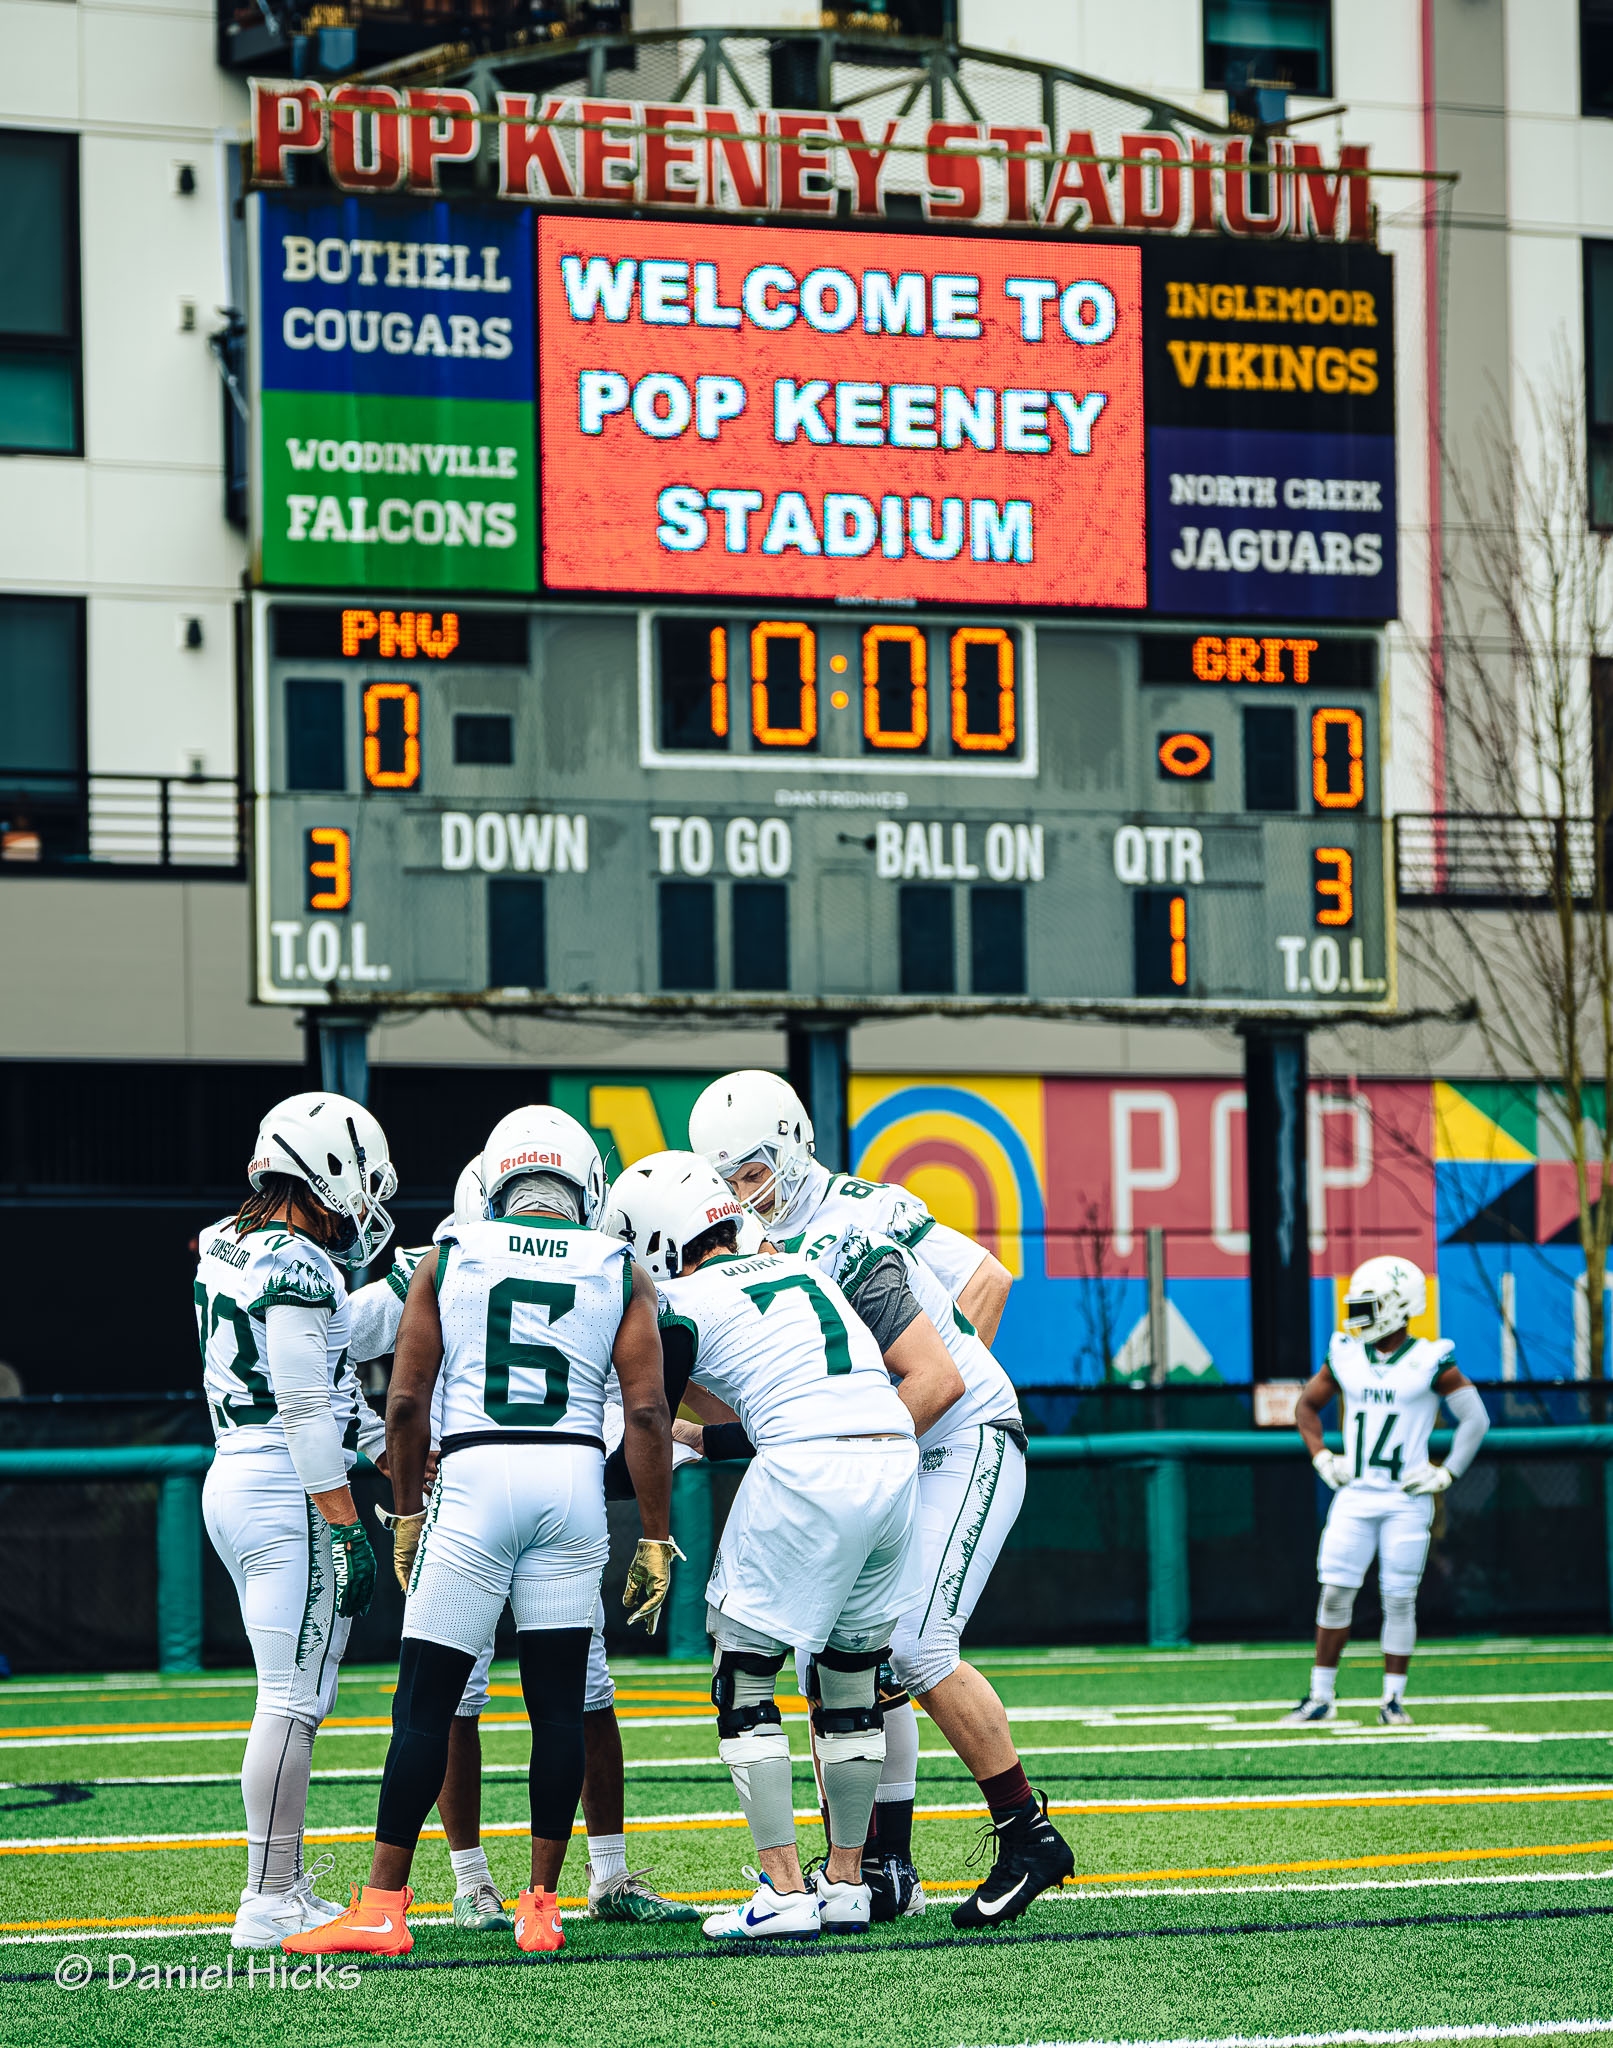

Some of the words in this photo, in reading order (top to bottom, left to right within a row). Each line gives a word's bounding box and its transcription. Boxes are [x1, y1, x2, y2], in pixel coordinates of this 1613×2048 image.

[248, 77, 480, 197] POP
[496, 91, 899, 219] KEENEY
[924, 120, 1374, 243] STADIUM
[282, 235, 512, 292] BOTHELL
[560, 255, 982, 340] WELCOME
[1005, 277, 1117, 346] TO
[1166, 281, 1378, 327] INGLEMOOR
[282, 307, 513, 360] COUGARS
[1167, 340, 1379, 395] VIKINGS
[579, 369, 748, 441] POP
[774, 378, 1107, 456] KEENEY
[286, 437, 518, 479] WOODINVILLE
[286, 494, 518, 548] FALCONS
[1169, 473, 1277, 509] NORTH
[1283, 477, 1383, 512] CREEK
[656, 484, 1035, 564] STADIUM
[1171, 526, 1383, 576] JAGUARS
[341, 609, 460, 659] PNW
[1191, 635, 1319, 684] GRIT
[709, 620, 1016, 751] 10:00
[363, 683, 421, 788] 0
[1311, 707, 1365, 808] 0
[774, 788, 909, 811] DAKTRONICS
[310, 827, 352, 911] 3
[440, 811, 589, 873] DOWN
[650, 816, 714, 876] TO
[725, 817, 793, 878] GO
[875, 820, 979, 879] BALL
[985, 822, 1045, 882] ON
[1113, 826, 1205, 885] QTR
[1315, 846, 1354, 927] 3
[270, 921, 392, 982] T.O.L.
[1169, 897, 1188, 987] 1
[1274, 935, 1388, 994] T.O.L.
[500, 1151, 562, 1174] Riddell
[508, 1235, 569, 1258] DAVIS
[483, 1276, 577, 1428] 6
[740, 1272, 854, 1377] 7
[1362, 1387, 1397, 1405] PNW
[1355, 1411, 1404, 1482] 14
